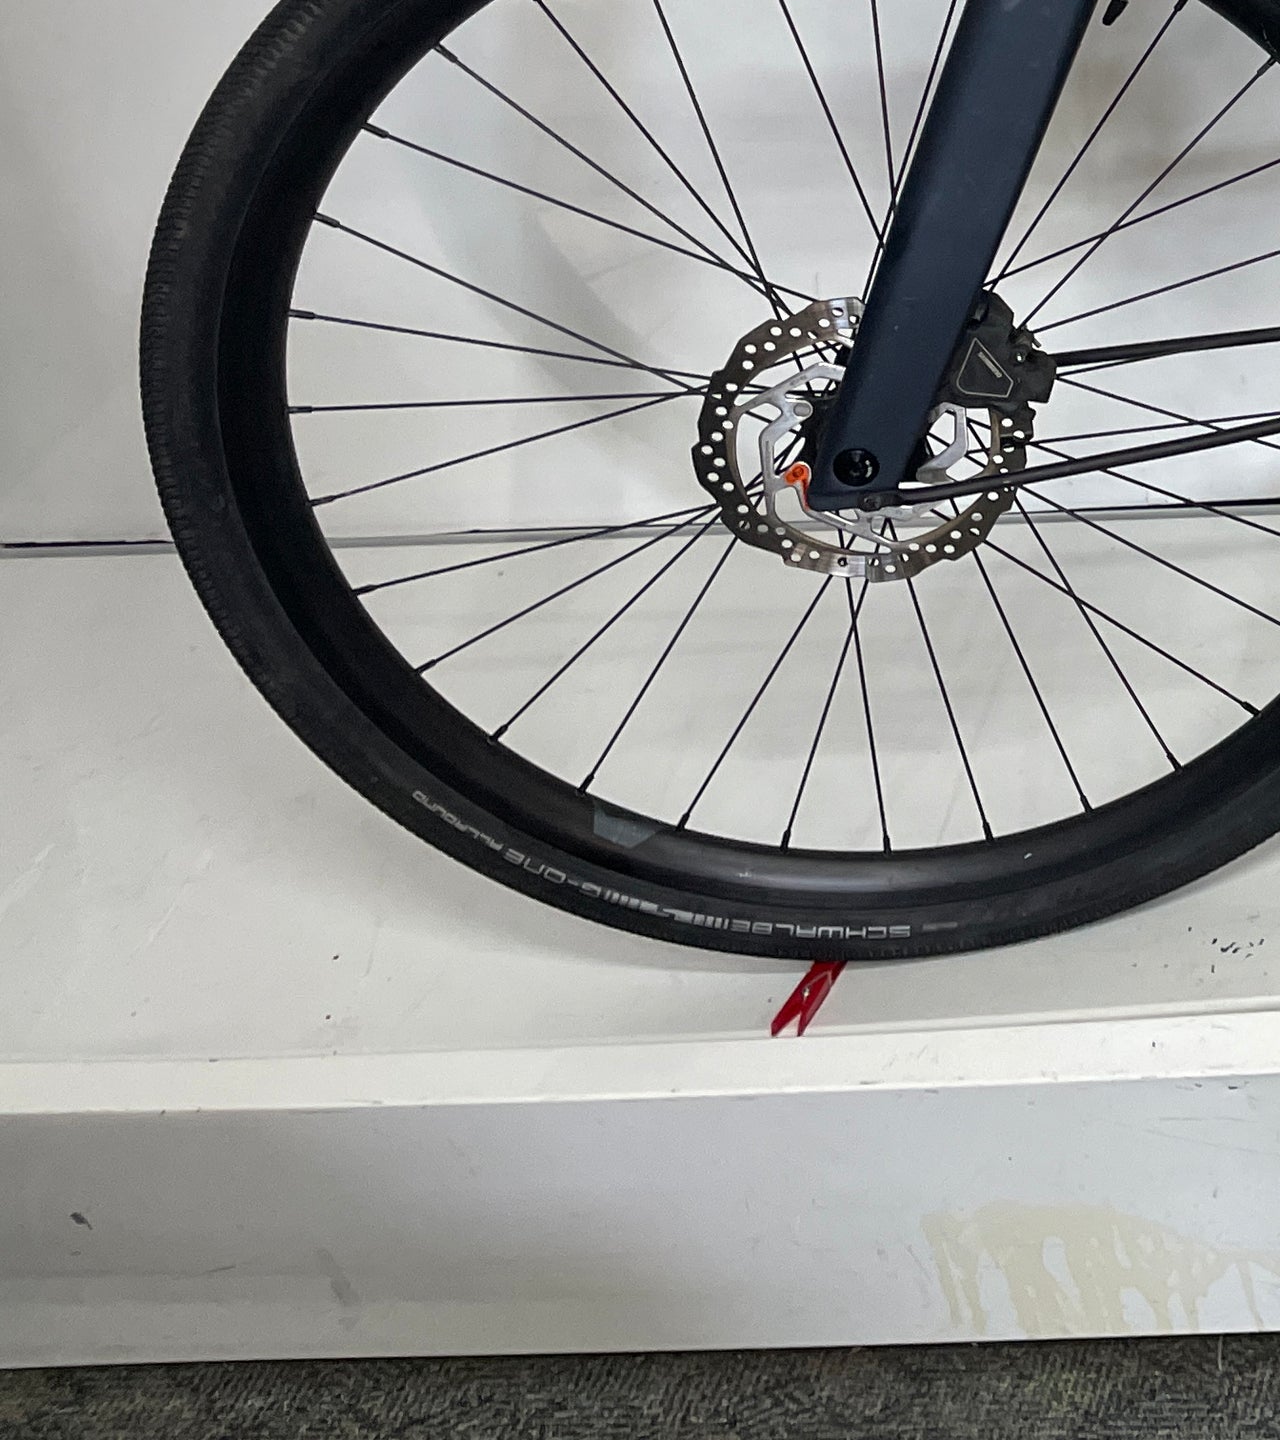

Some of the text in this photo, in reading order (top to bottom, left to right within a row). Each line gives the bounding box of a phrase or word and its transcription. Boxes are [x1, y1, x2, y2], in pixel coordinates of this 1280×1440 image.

[411, 789, 911, 940] SCHWALBE G-ONE ALLROUND
